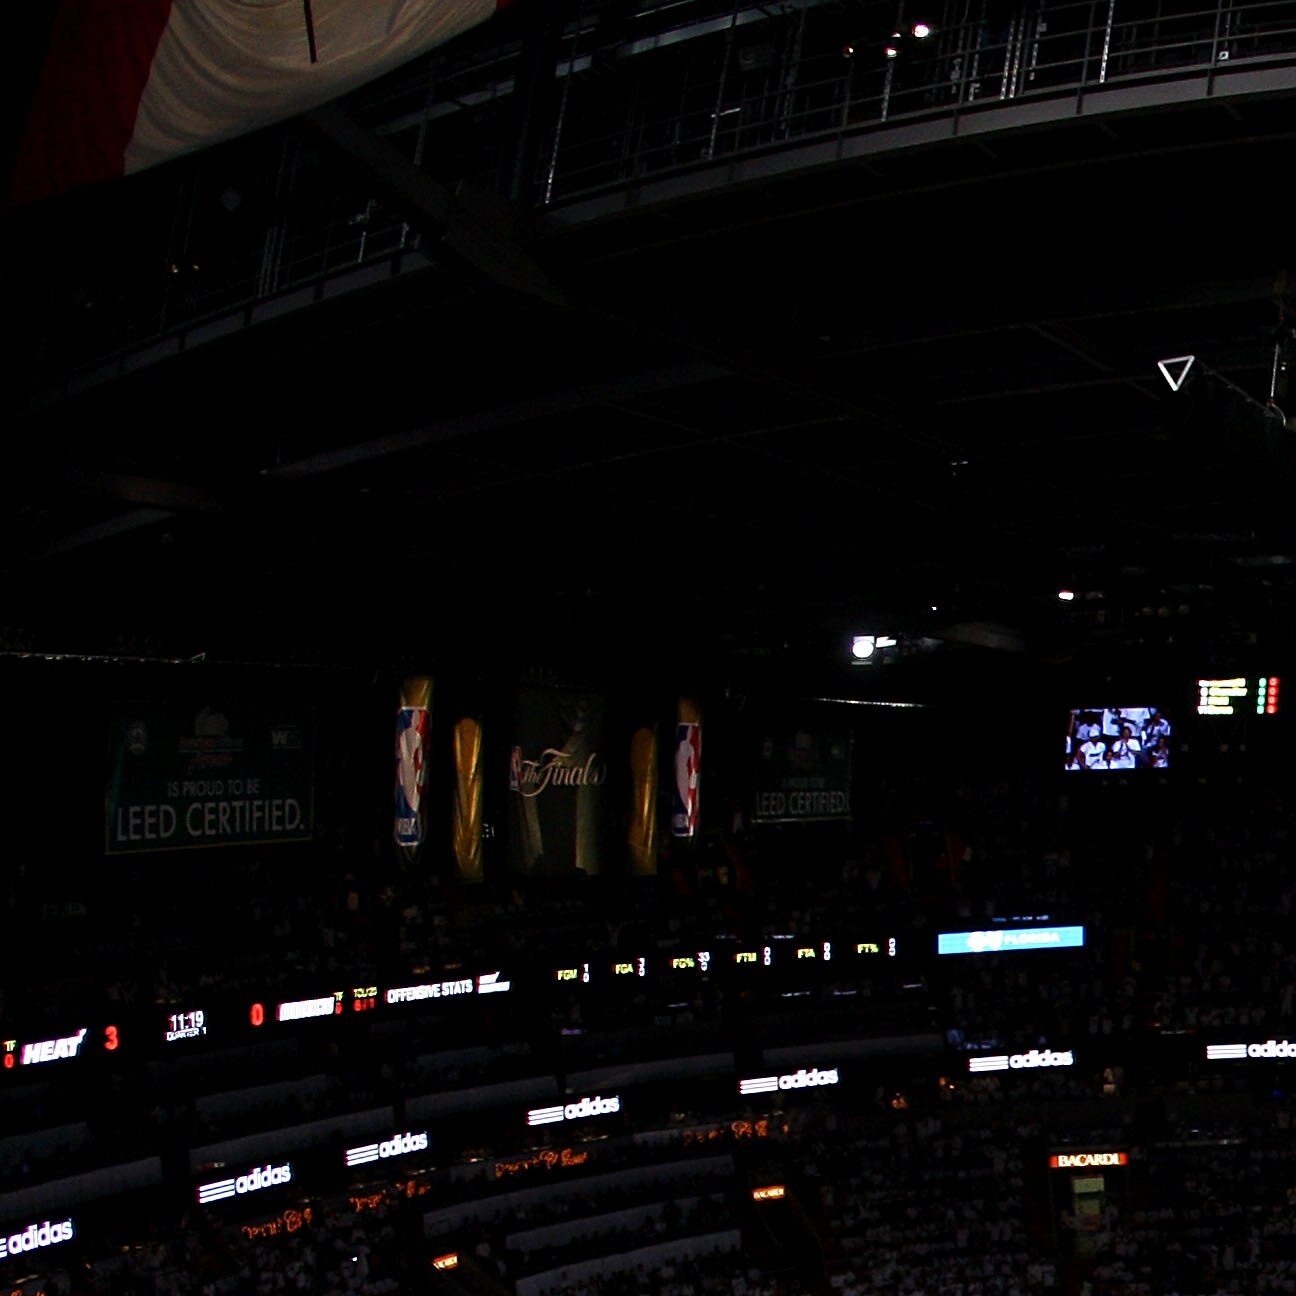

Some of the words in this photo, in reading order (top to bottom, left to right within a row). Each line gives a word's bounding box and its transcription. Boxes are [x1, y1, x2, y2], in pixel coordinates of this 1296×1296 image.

[532, 747, 606, 792] Finals
[182, 780, 225, 797] PROUD
[227, 780, 243, 796] TO
[116, 803, 177, 842] LEED
[185, 798, 305, 837] CERTIFIED.
[386, 983, 441, 1004] OFFENSIVE
[442, 979, 474, 997] STATS
[21, 1028, 87, 1066] HEAT
[103, 1025, 120, 1051] 3
[169, 1010, 205, 1031] 11:19
[250, 1002, 264, 1026] 0
[1009, 1048, 1074, 1069] adidas
[778, 1067, 840, 1091] adidas
[564, 1095, 621, 1120] adidas
[379, 1131, 428, 1158] adidas
[1057, 1152, 1120, 1167] BACARDI
[235, 1163, 291, 1194] adidas
[8, 1219, 74, 1254] adidas
